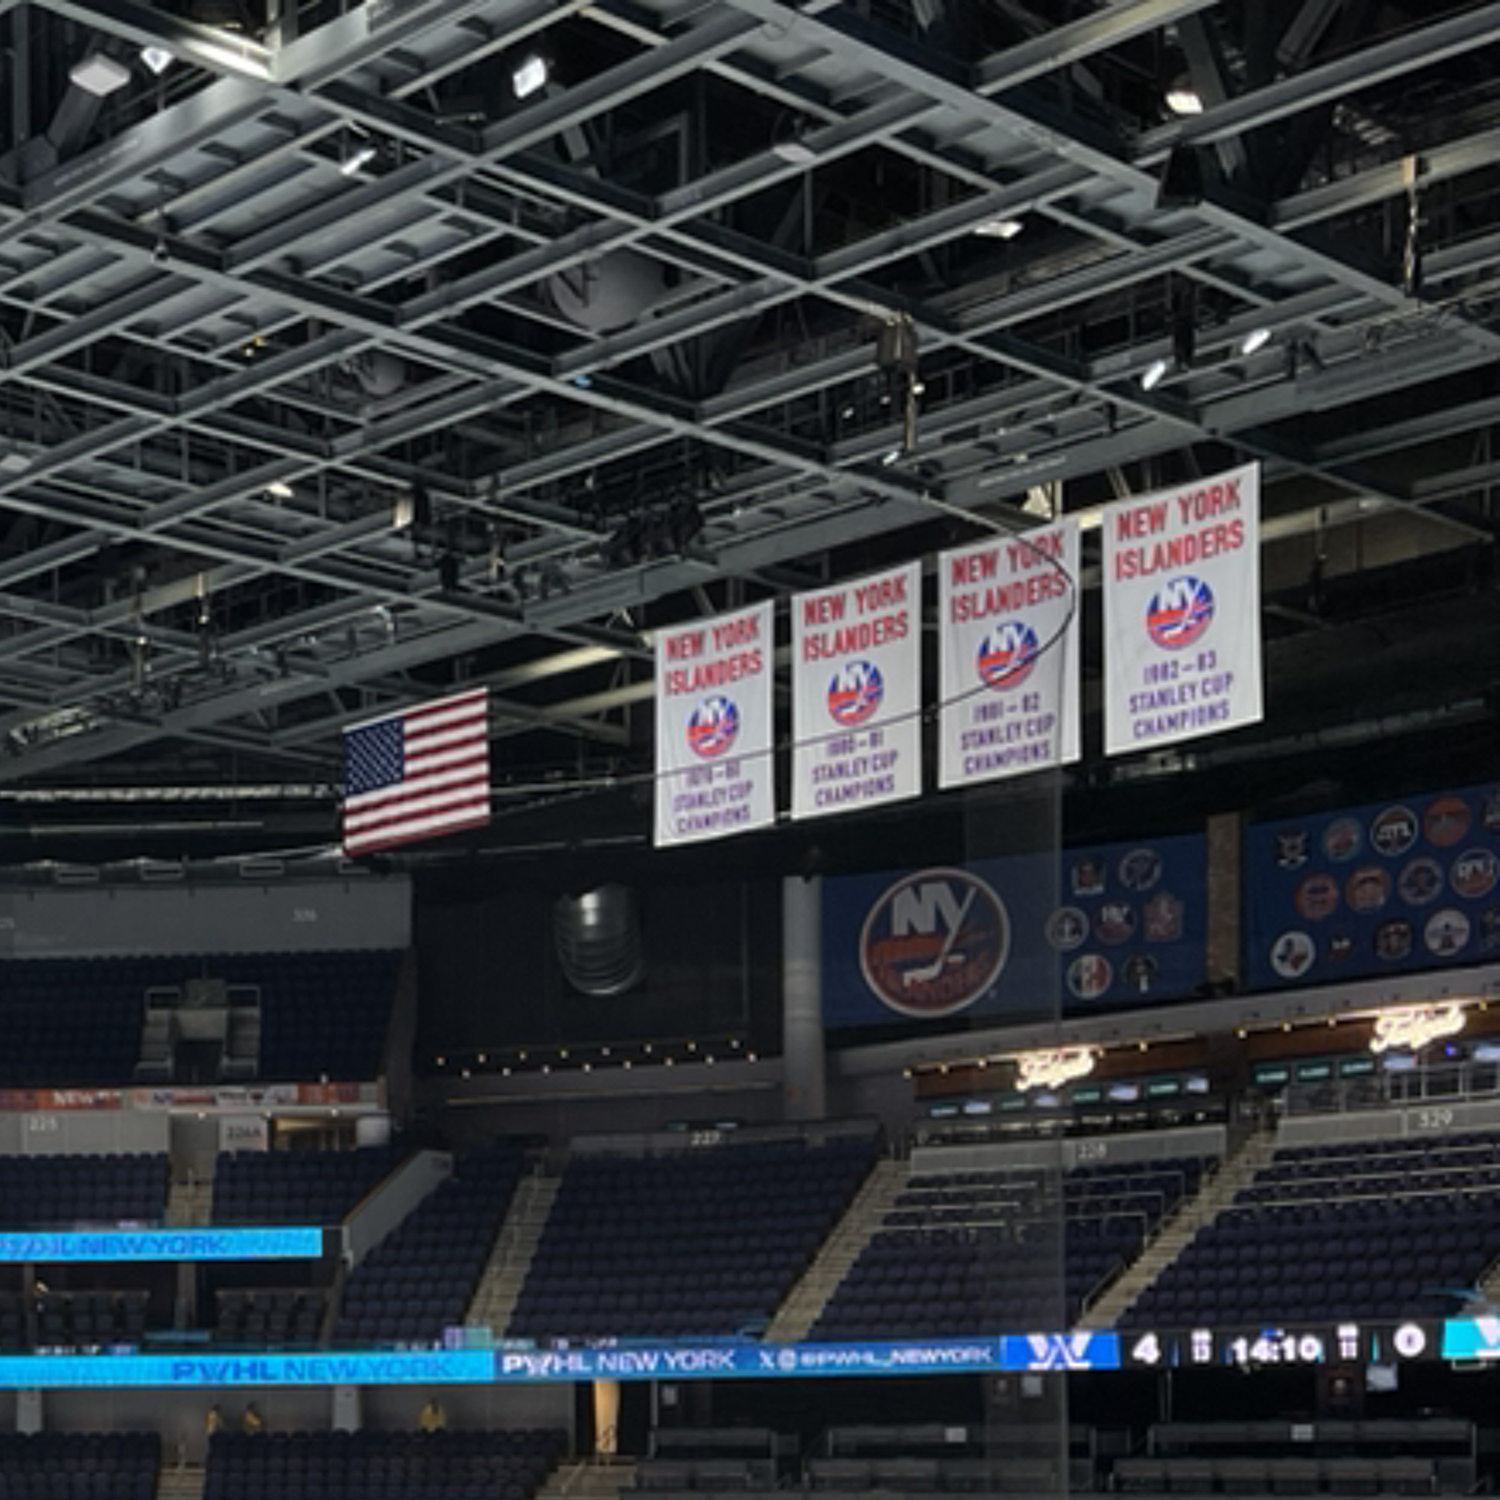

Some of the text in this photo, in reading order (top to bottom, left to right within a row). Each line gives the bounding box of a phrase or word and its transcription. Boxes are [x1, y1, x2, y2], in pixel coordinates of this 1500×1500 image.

[1116, 479, 1241, 541] NEW YORK
[951, 530, 1065, 586] NEW YORK
[1114, 519, 1244, 581] ISLANDERS
[804, 575, 907, 627] NEW YORK
[951, 569, 1067, 622] ISLANDERS
[664, 613, 761, 660] NEW YORK
[802, 610, 909, 662] ISLANDERS
[664, 648, 763, 694] ISLANDERS
[1129, 672, 1233, 714] STANLEY CUP
[961, 714, 1055, 750] STANLEY CUP
[1133, 700, 1230, 739] CHAMPIONS
[872, 749, 899, 770] CUP
[965, 741, 1050, 776] CHAMPIONS
[815, 775, 895, 808] CHAMPIONS
[80, 1235, 146, 1256] NEW
[150, 1235, 227, 1255] YORK
[501, 1348, 737, 1378] PWHL NEW YORK
[1131, 1331, 1161, 1364] 4
[1231, 1333, 1322, 1364] 14:10
[170, 1357, 455, 1382] PWHL NEW YORK
